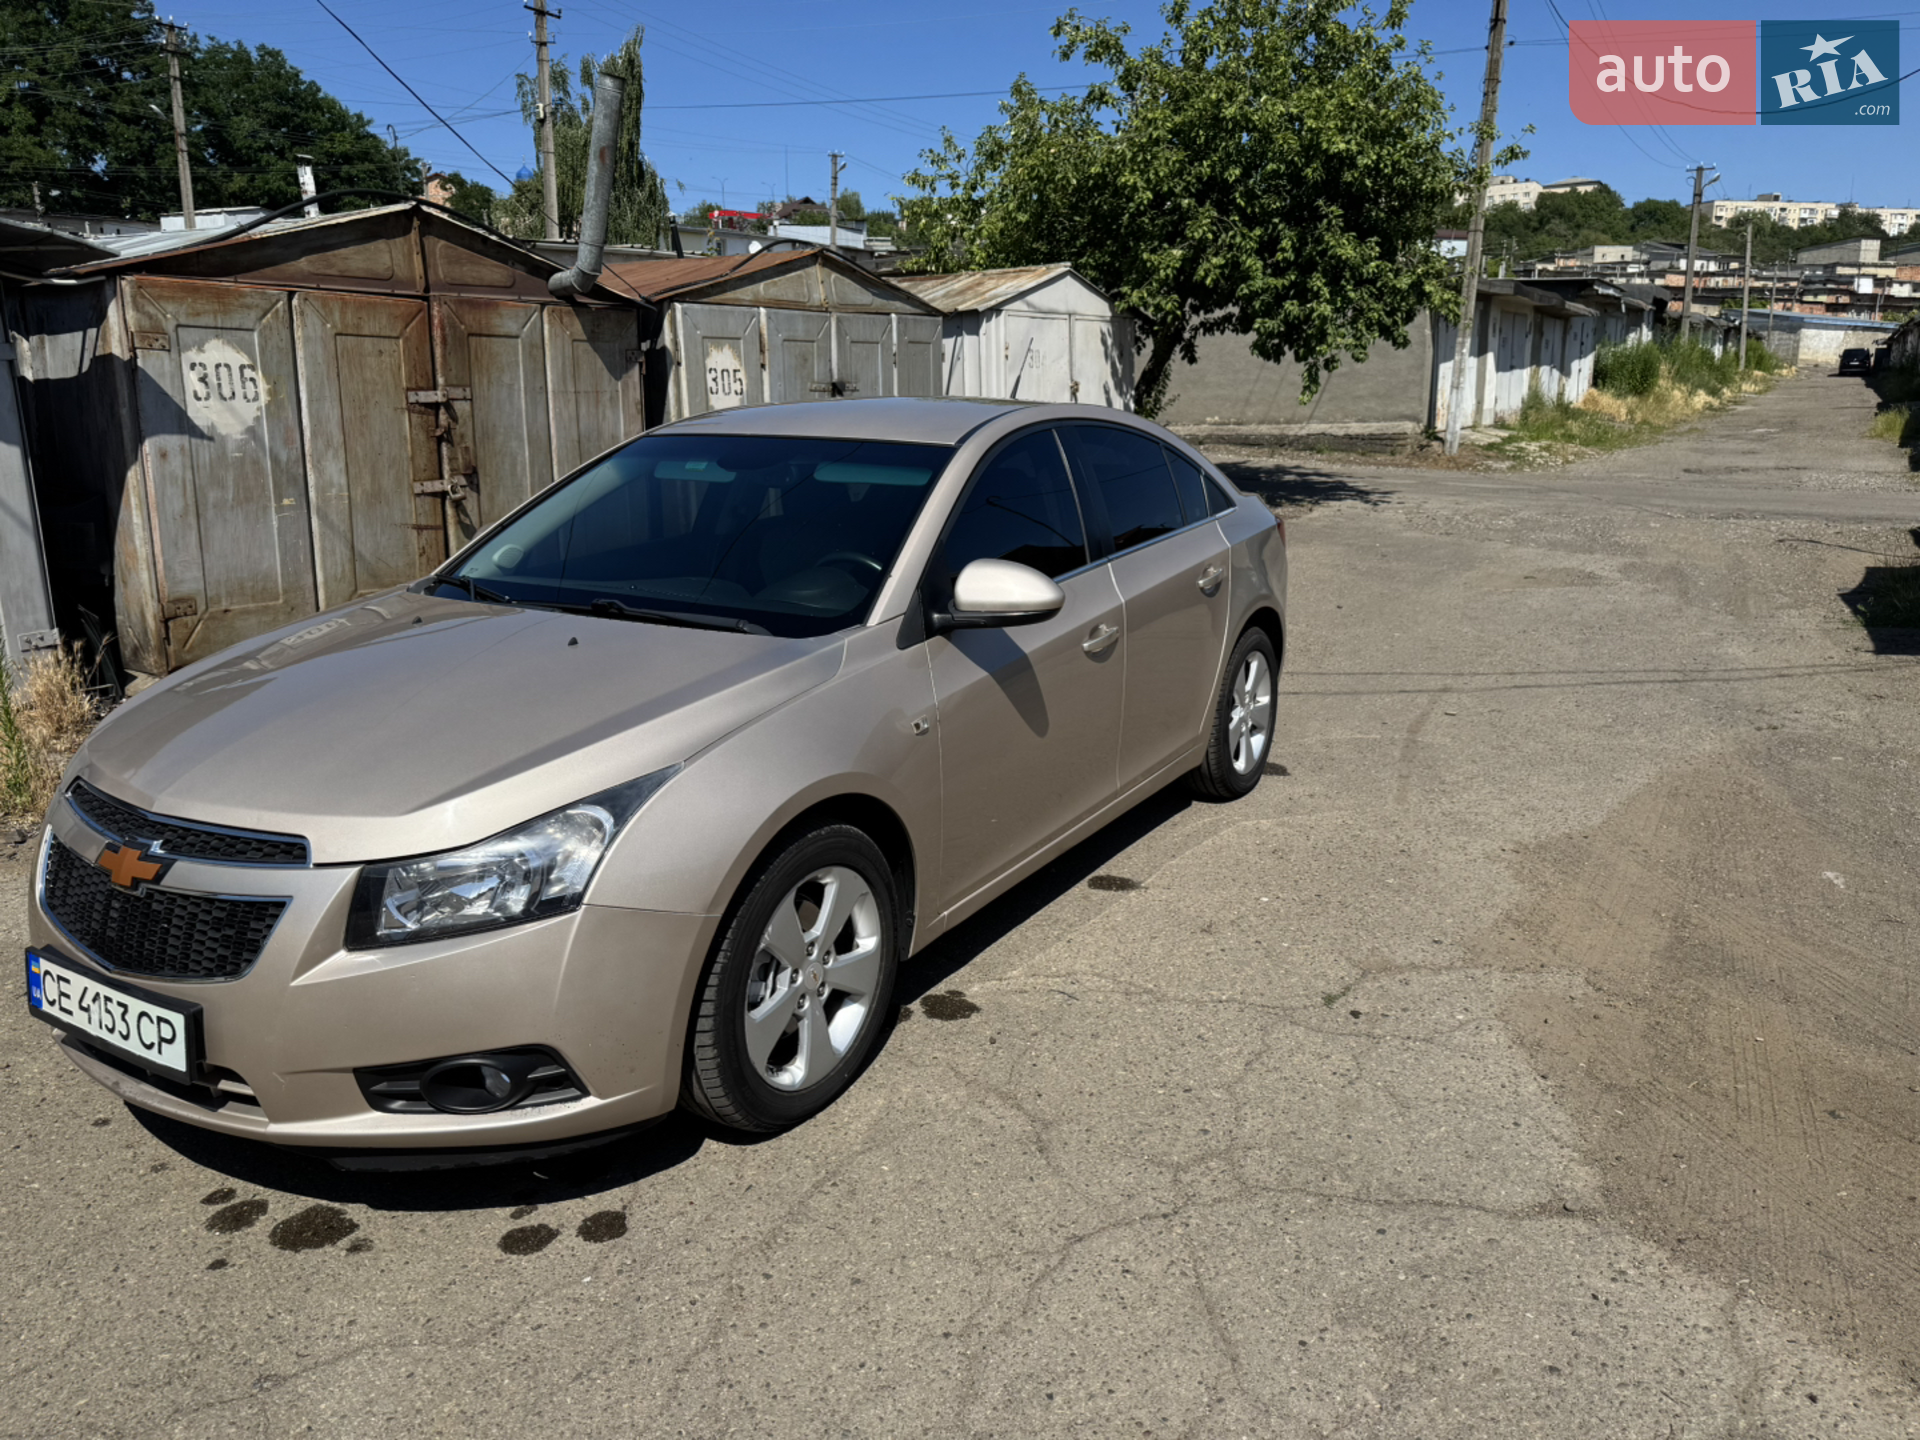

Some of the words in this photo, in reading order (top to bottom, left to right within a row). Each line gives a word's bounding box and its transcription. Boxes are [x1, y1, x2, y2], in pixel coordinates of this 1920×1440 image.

[189, 361, 260, 403] 306
[708, 367, 744, 396] 305
[42, 969, 74, 1017] CE
[78, 986, 130, 1042] 4153
[136, 1010, 177, 1056] CP
